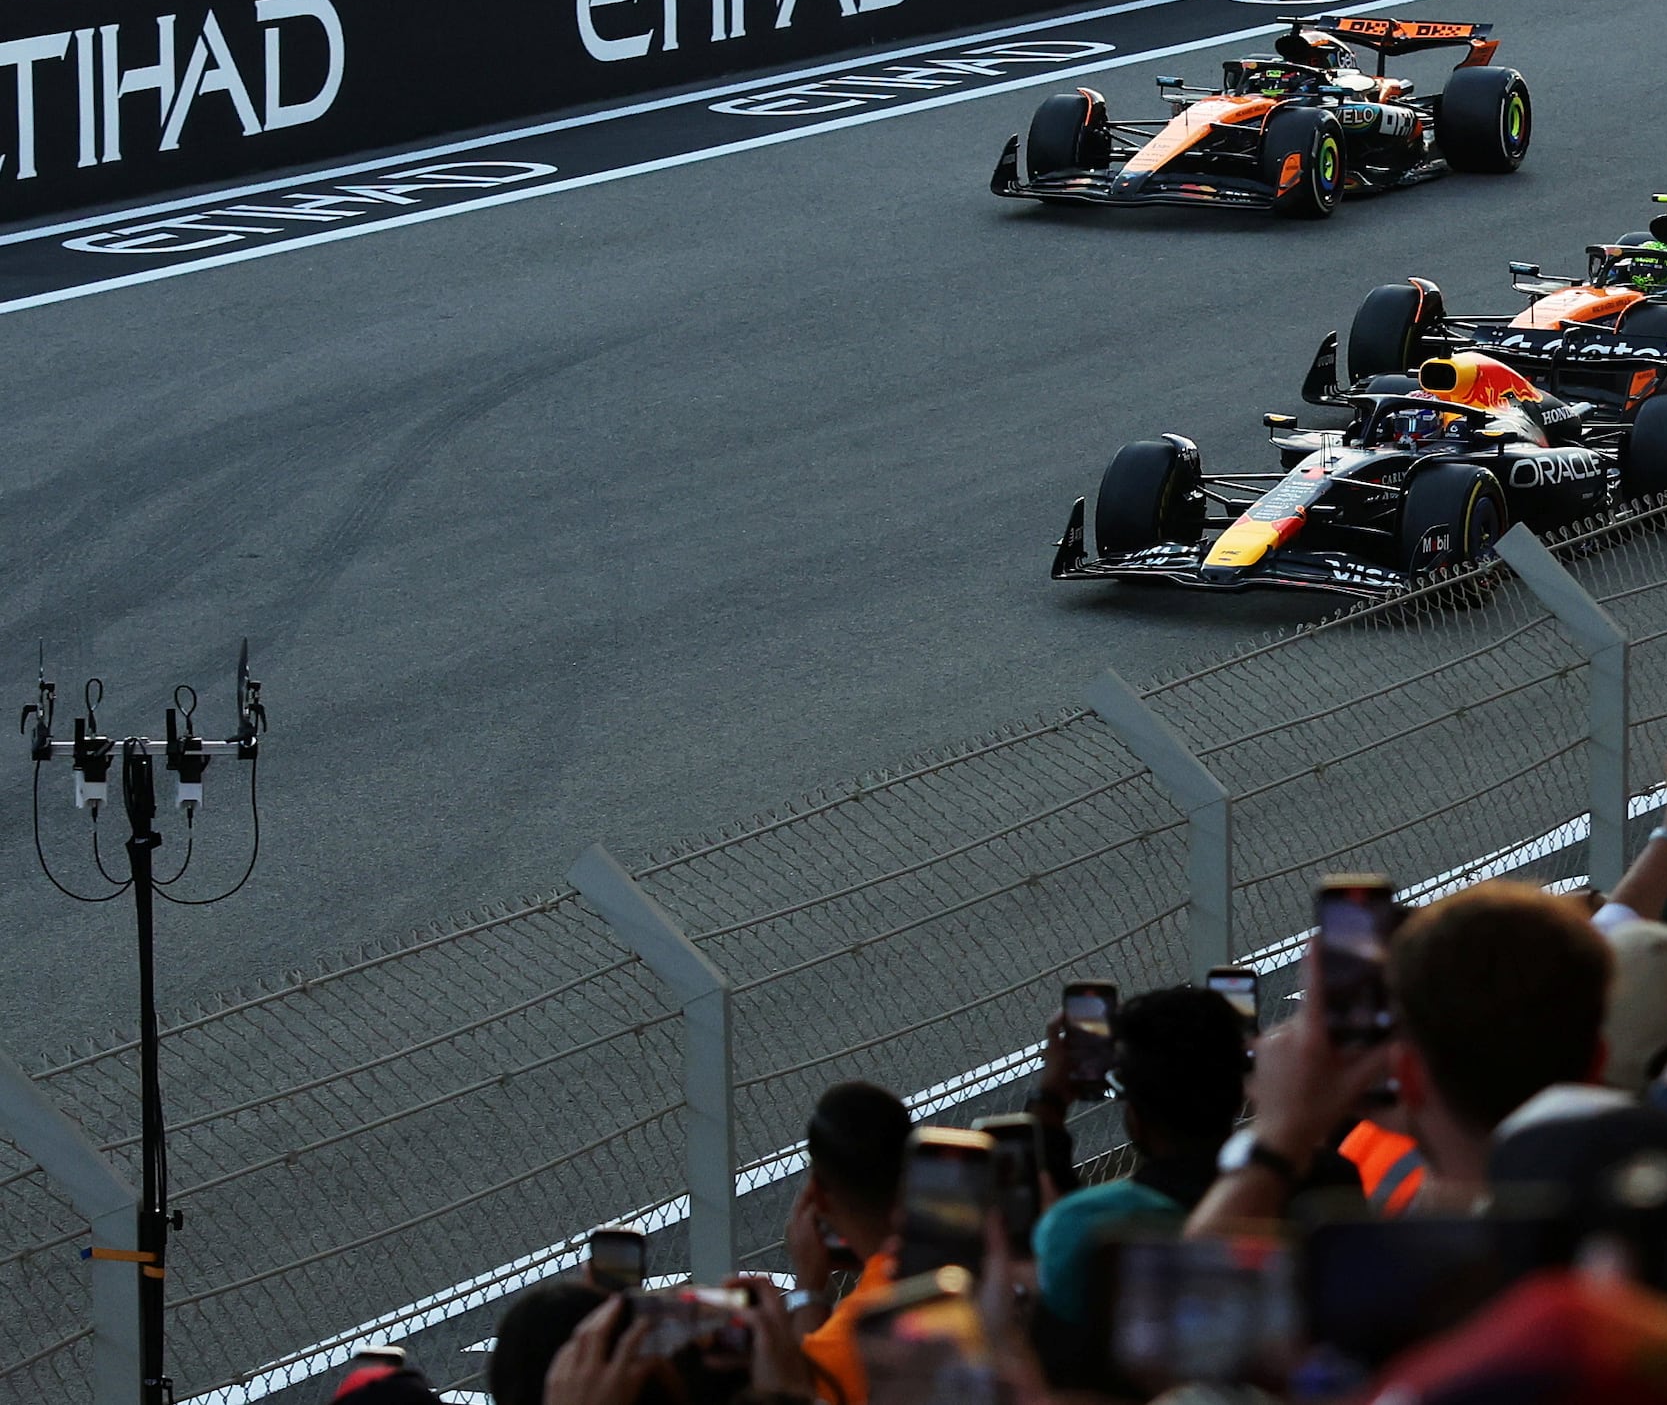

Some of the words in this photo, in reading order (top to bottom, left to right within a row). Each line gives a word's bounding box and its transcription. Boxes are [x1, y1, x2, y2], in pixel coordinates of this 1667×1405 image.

[710, 40, 1115, 116] ETIHAD
[1337, 107, 1373, 125] VELO
[61, 160, 557, 254] ETIHAD
[1542, 405, 1575, 425] HOND
[1381, 471, 1406, 485] CARLY
[1509, 458, 1602, 489] ORACLE
[1422, 533, 1450, 555] Mobil
